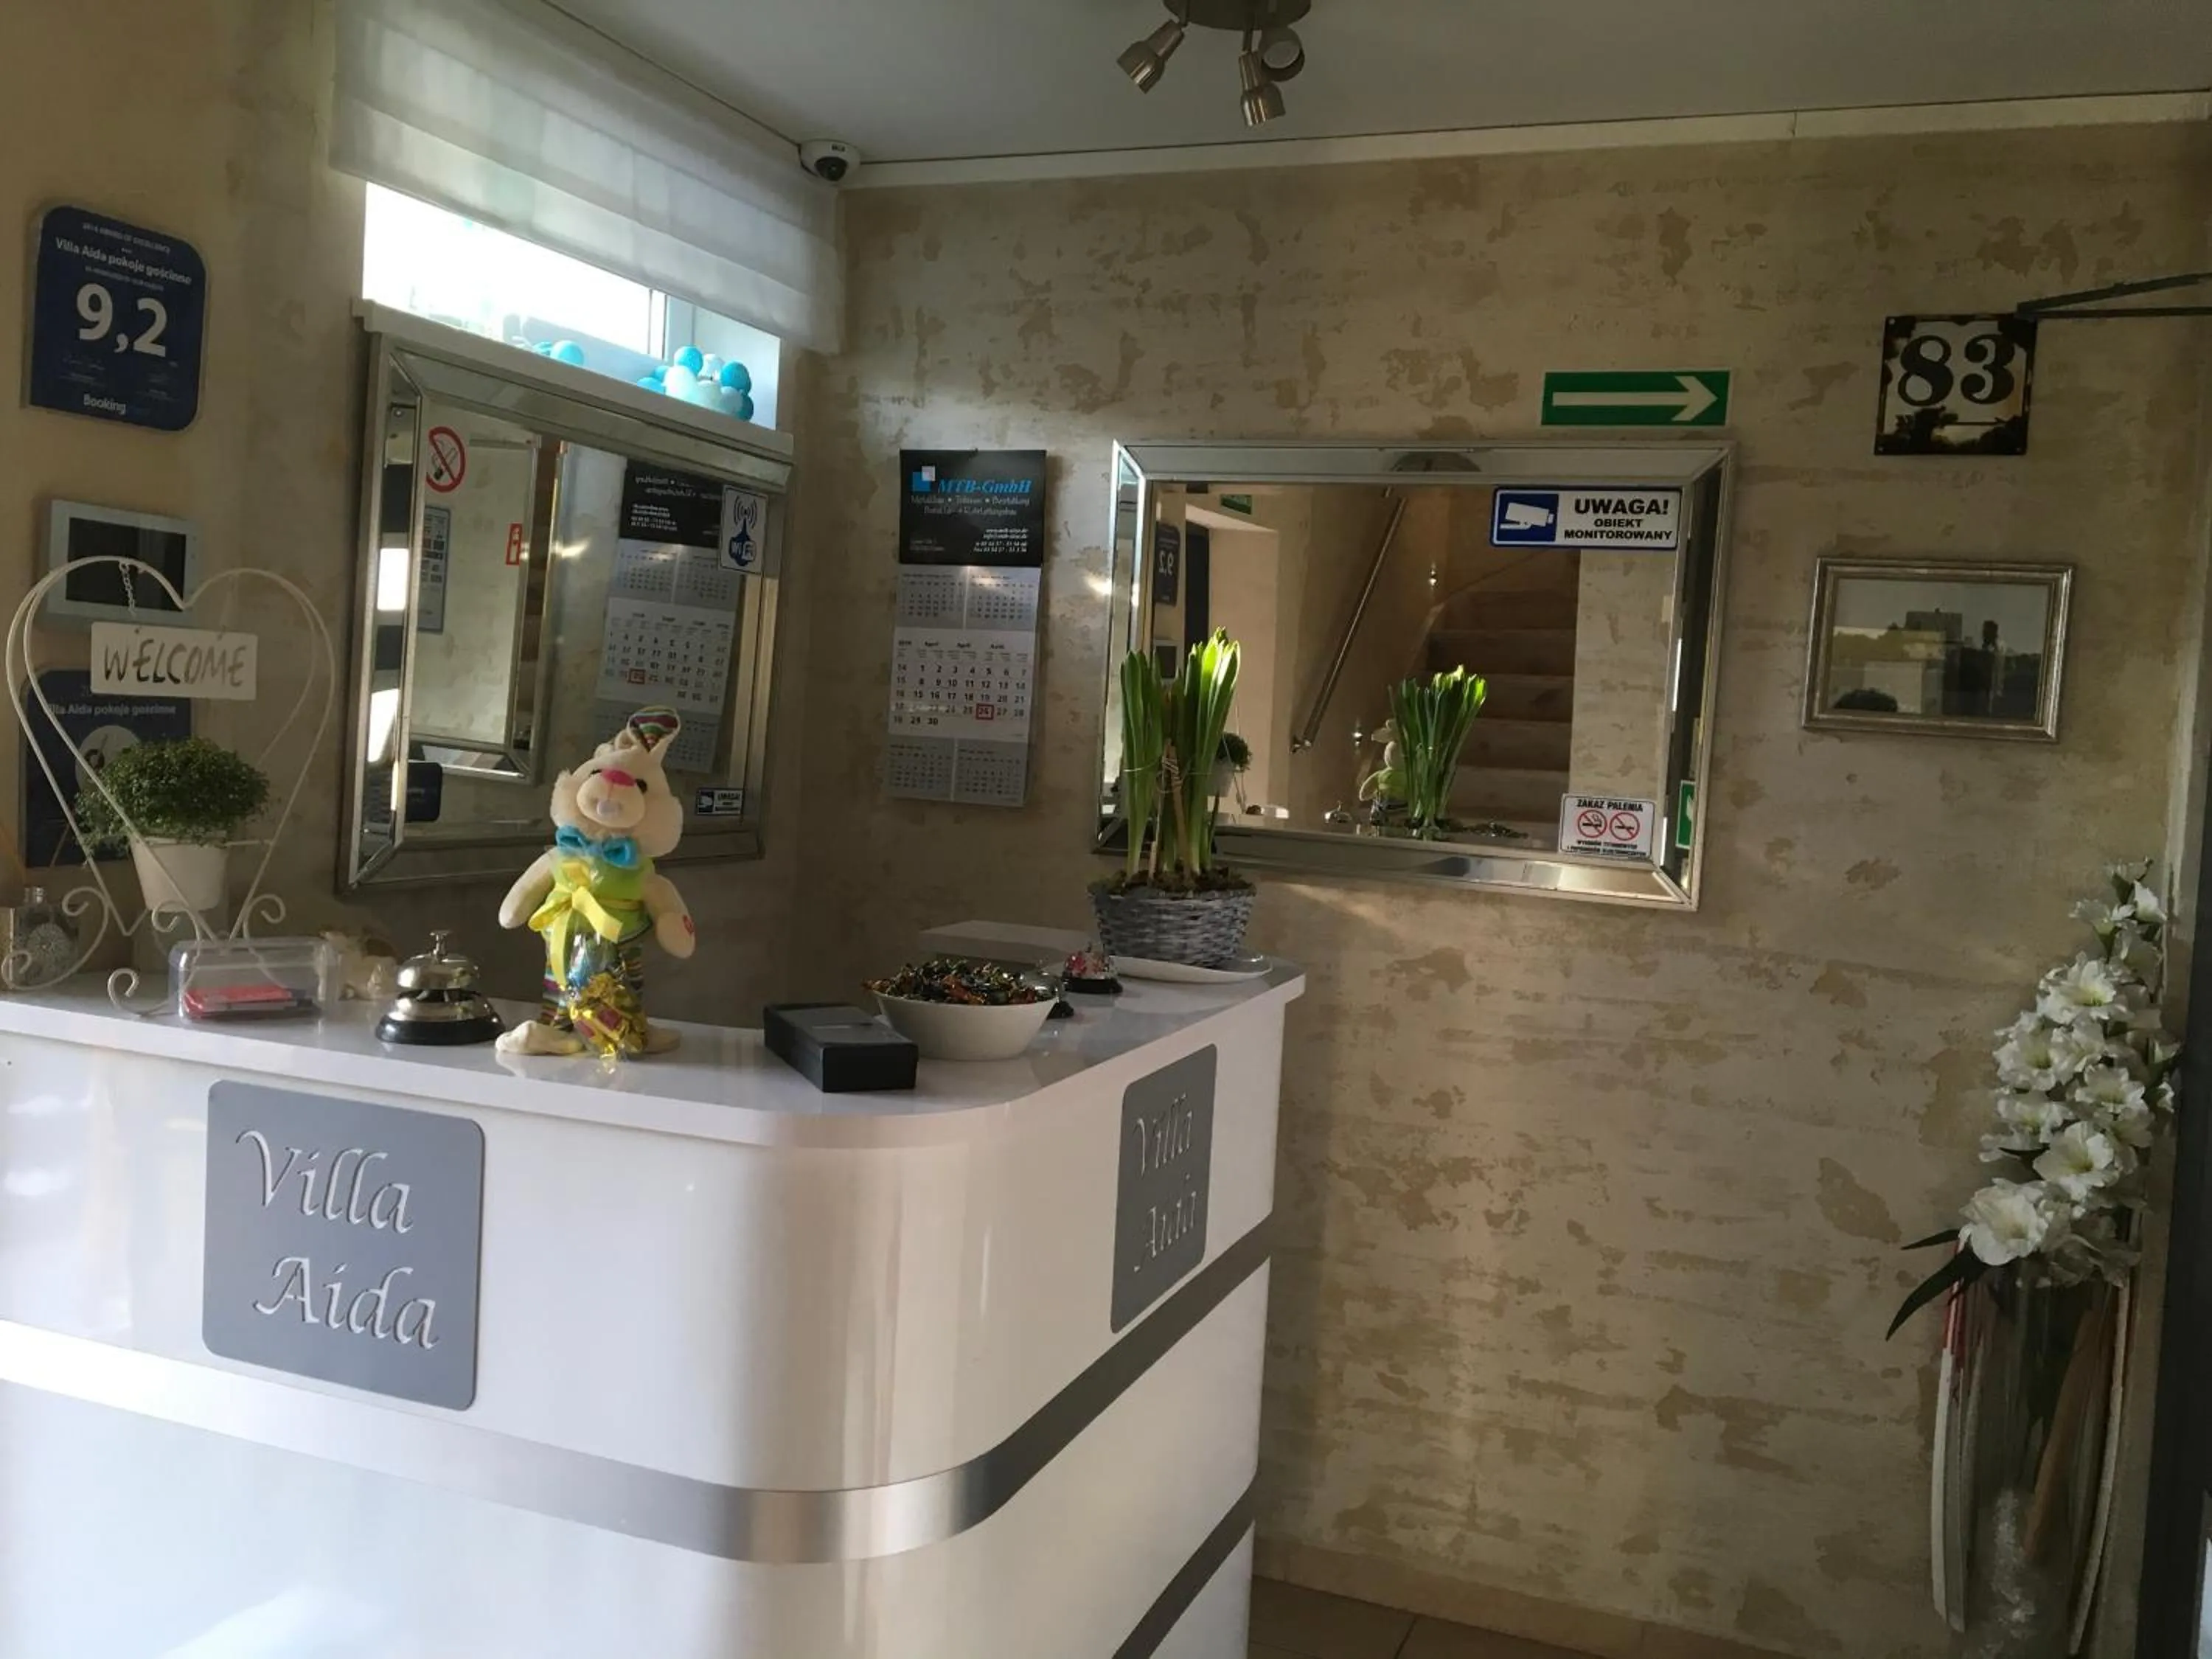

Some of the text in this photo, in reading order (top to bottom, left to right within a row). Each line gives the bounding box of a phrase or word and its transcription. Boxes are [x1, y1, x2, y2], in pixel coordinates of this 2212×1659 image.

[55, 237, 79, 254] Villa
[82, 245, 107, 262] Aida
[76, 283, 167, 358] 9,2
[1898, 334, 2014, 406] 83
[1574, 498, 1669, 515] UWAGA!
[1594, 518, 1643, 528] OBIEKT
[1564, 529, 1672, 540] MONITOROWANY
[104, 639, 247, 689] WELCOME
[965, 680, 974, 688] 11
[981, 681, 990, 689] 12
[914, 690, 924, 698] 15
[931, 691, 940, 699] 16
[928, 717, 939, 726] 30
[1576, 799, 1644, 812] ZAKAZ PALENIA
[236, 1130, 414, 1234] Villa
[253, 1257, 439, 1350] Aida
